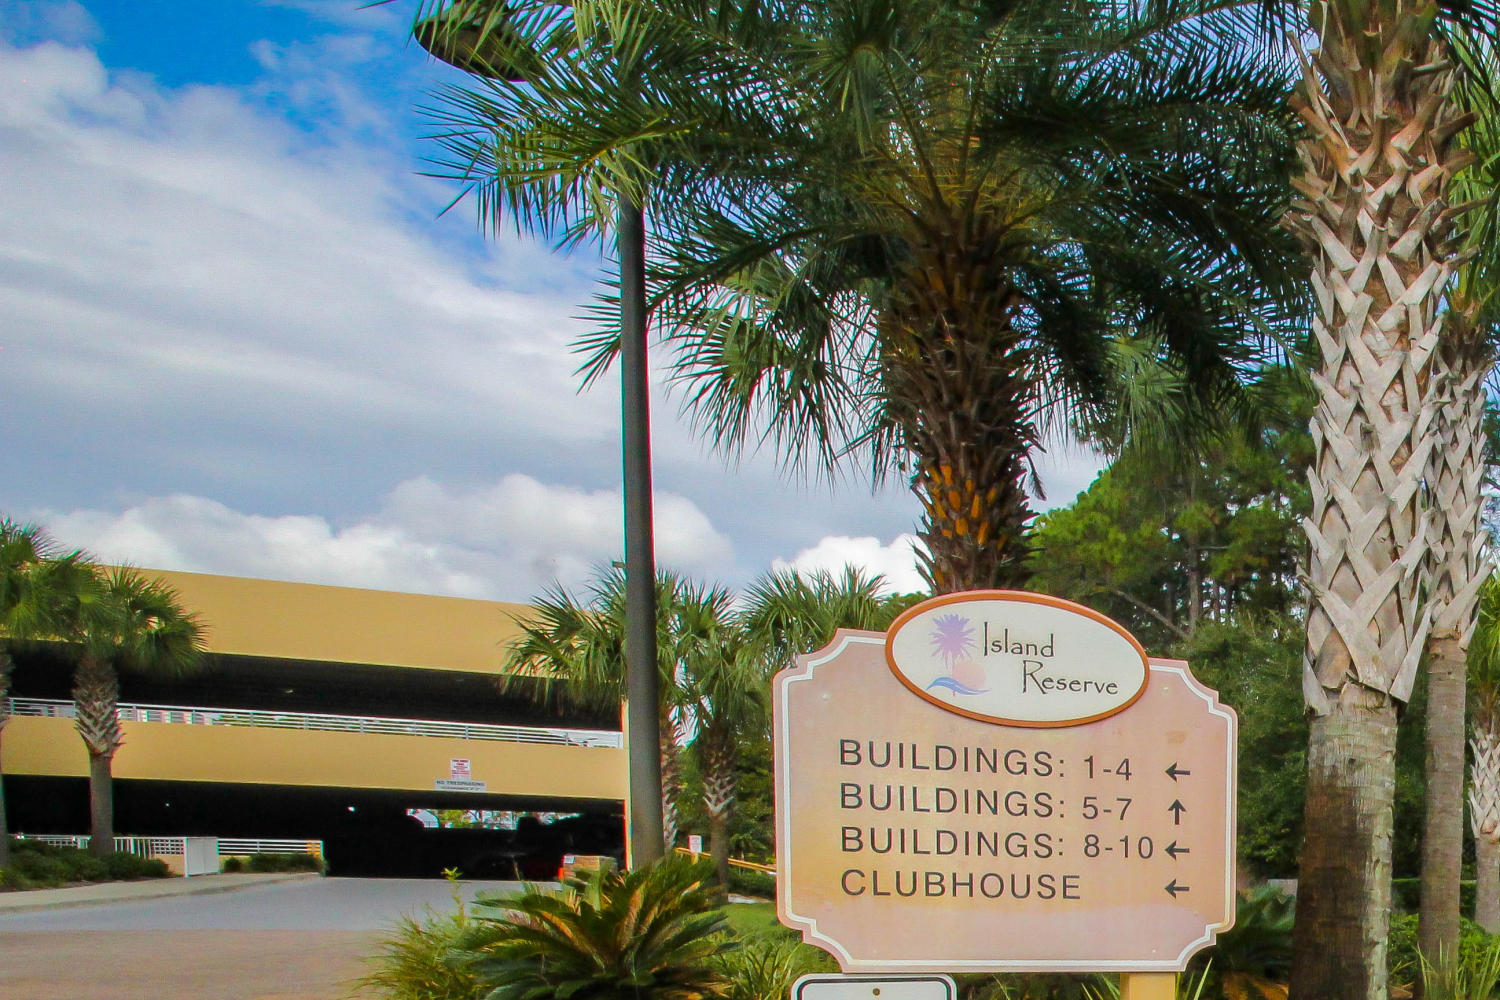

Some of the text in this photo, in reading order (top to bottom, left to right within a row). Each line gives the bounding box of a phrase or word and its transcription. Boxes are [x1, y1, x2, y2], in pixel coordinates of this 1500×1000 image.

[984, 621, 1055, 658] Island
[1022, 659, 1118, 696] Reserve
[839, 739, 1133, 781] BUILDINGS: 1-4
[840, 783, 1133, 821] BUILDINGS: 5-7
[841, 826, 1154, 860] BUILDINGS: 8-10
[841, 869, 1081, 900] CLUBHOUSE
